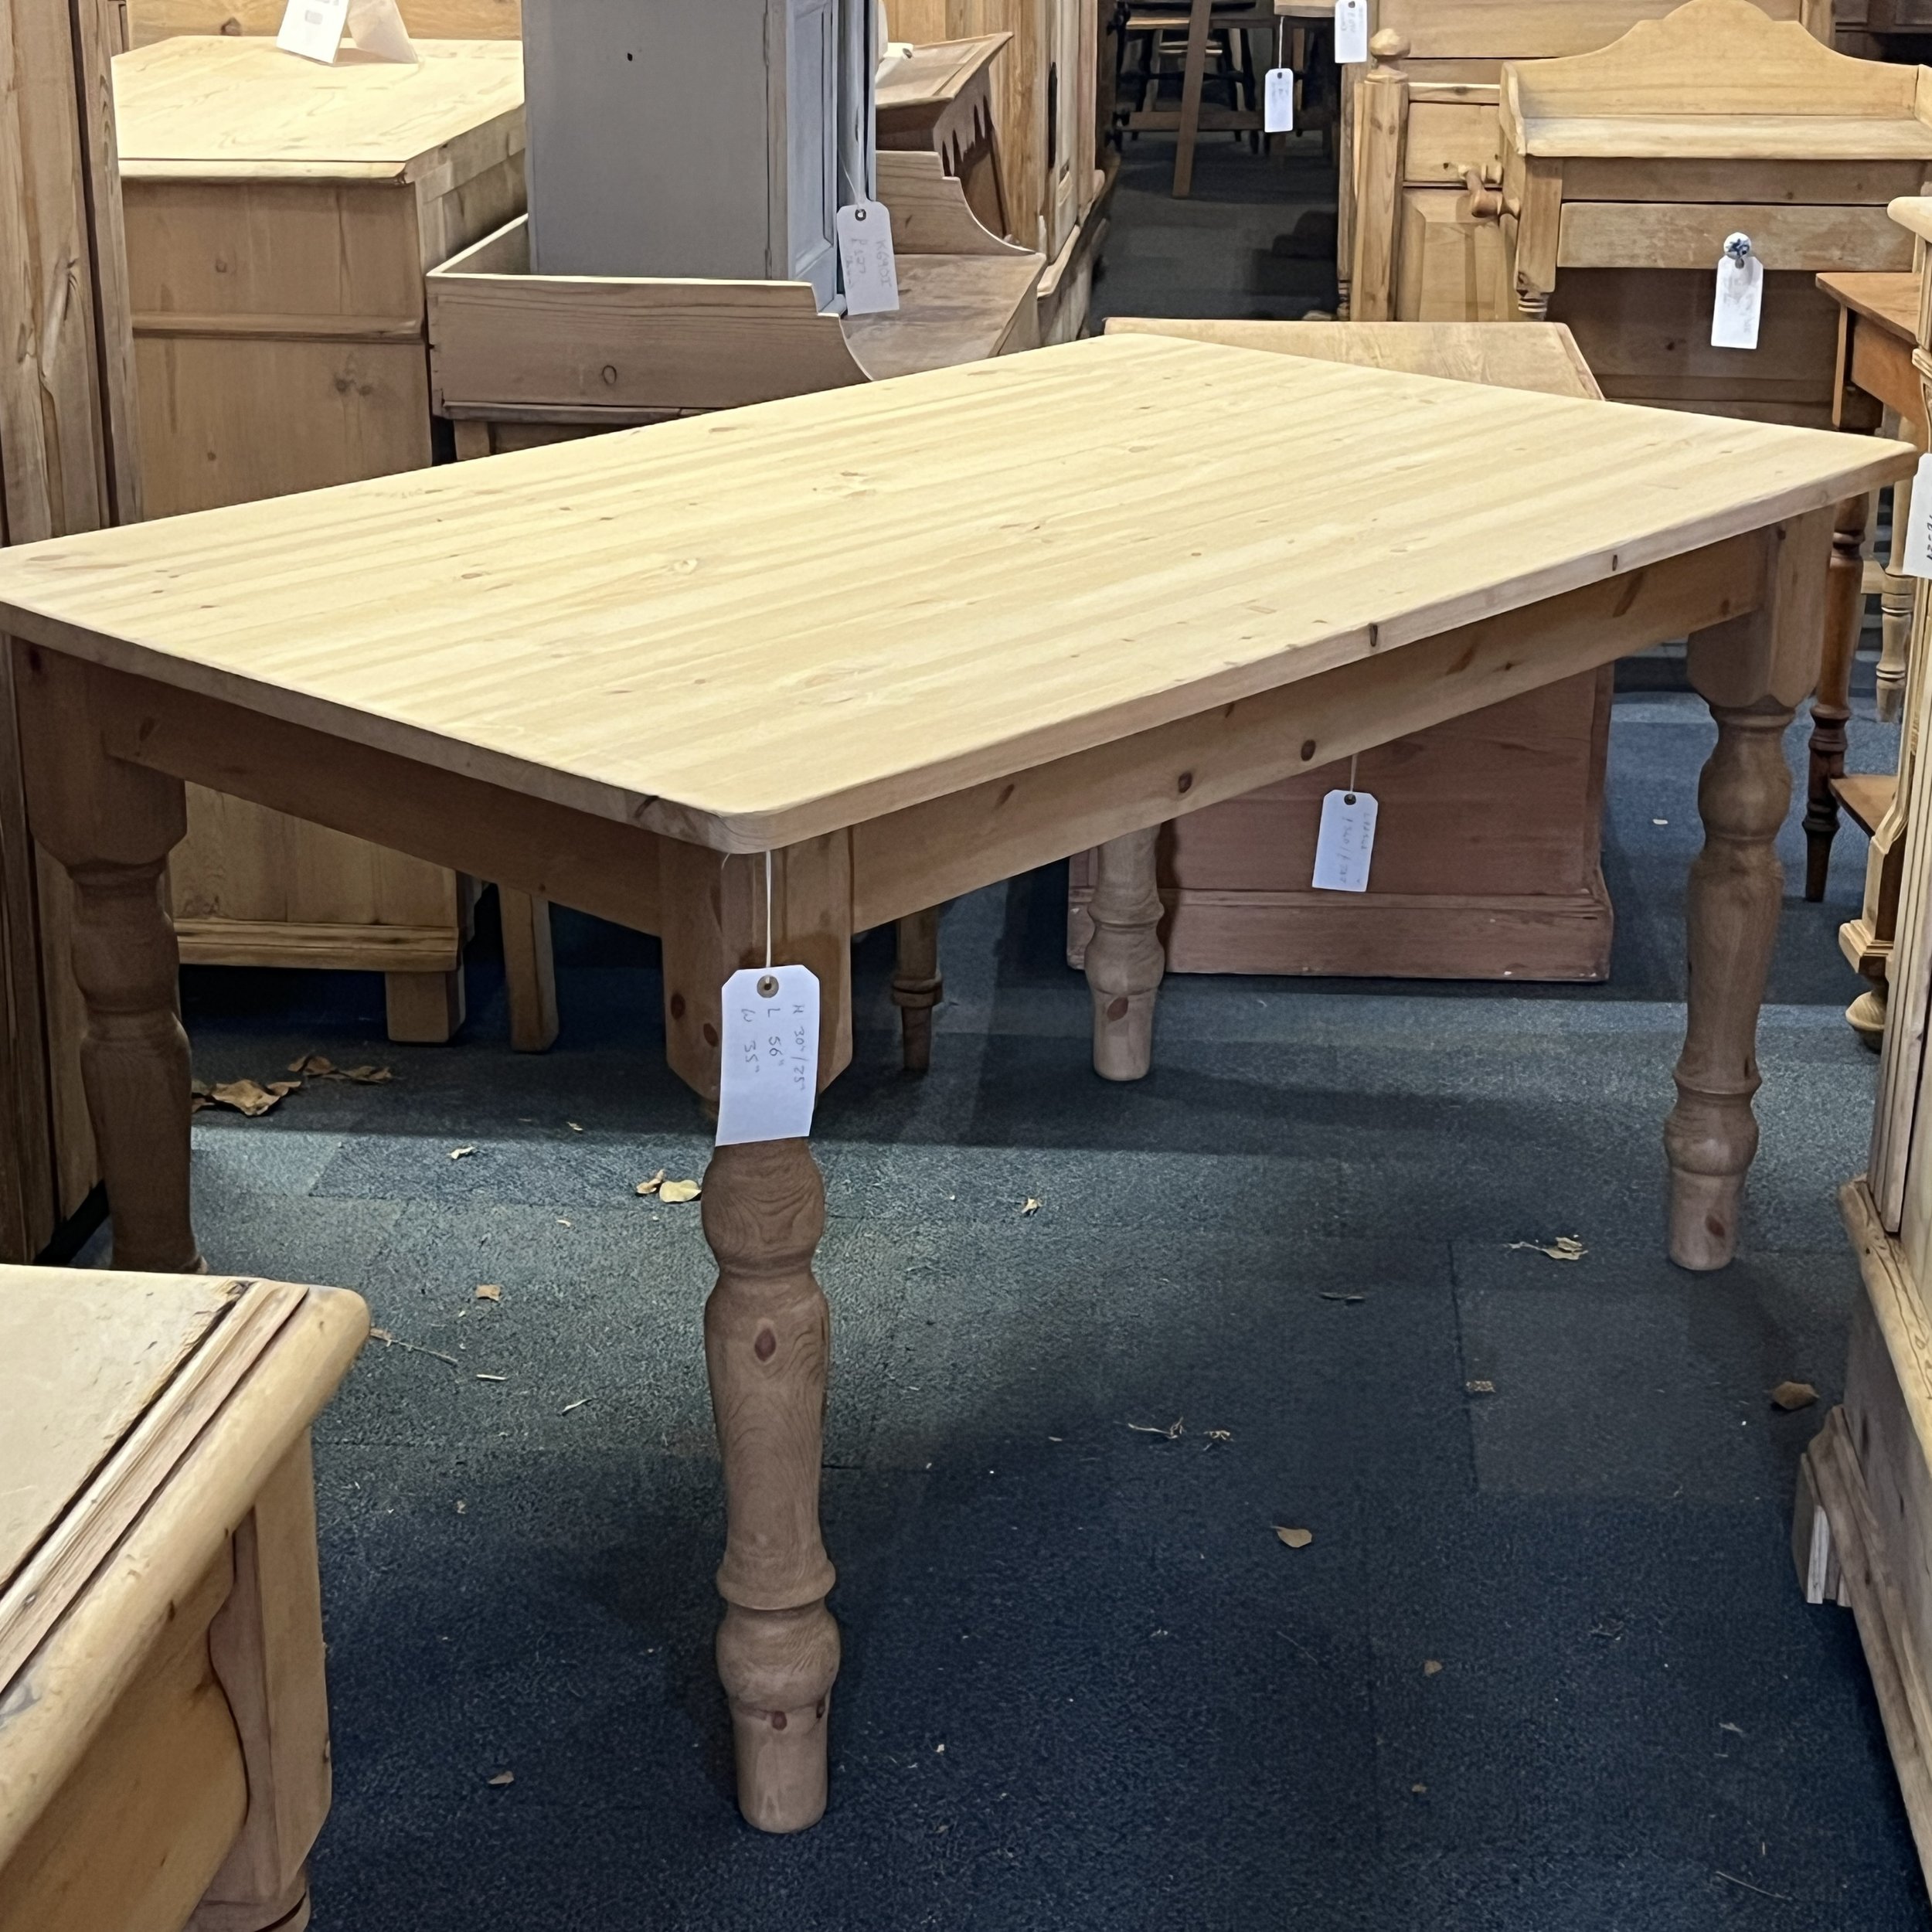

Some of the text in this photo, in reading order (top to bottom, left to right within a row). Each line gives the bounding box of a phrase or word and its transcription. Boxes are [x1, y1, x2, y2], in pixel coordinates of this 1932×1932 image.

[767, 1008, 784, 1067] L 56"
[793, 1004, 804, 1014] H
[741, 1008, 760, 1073] W 35"
